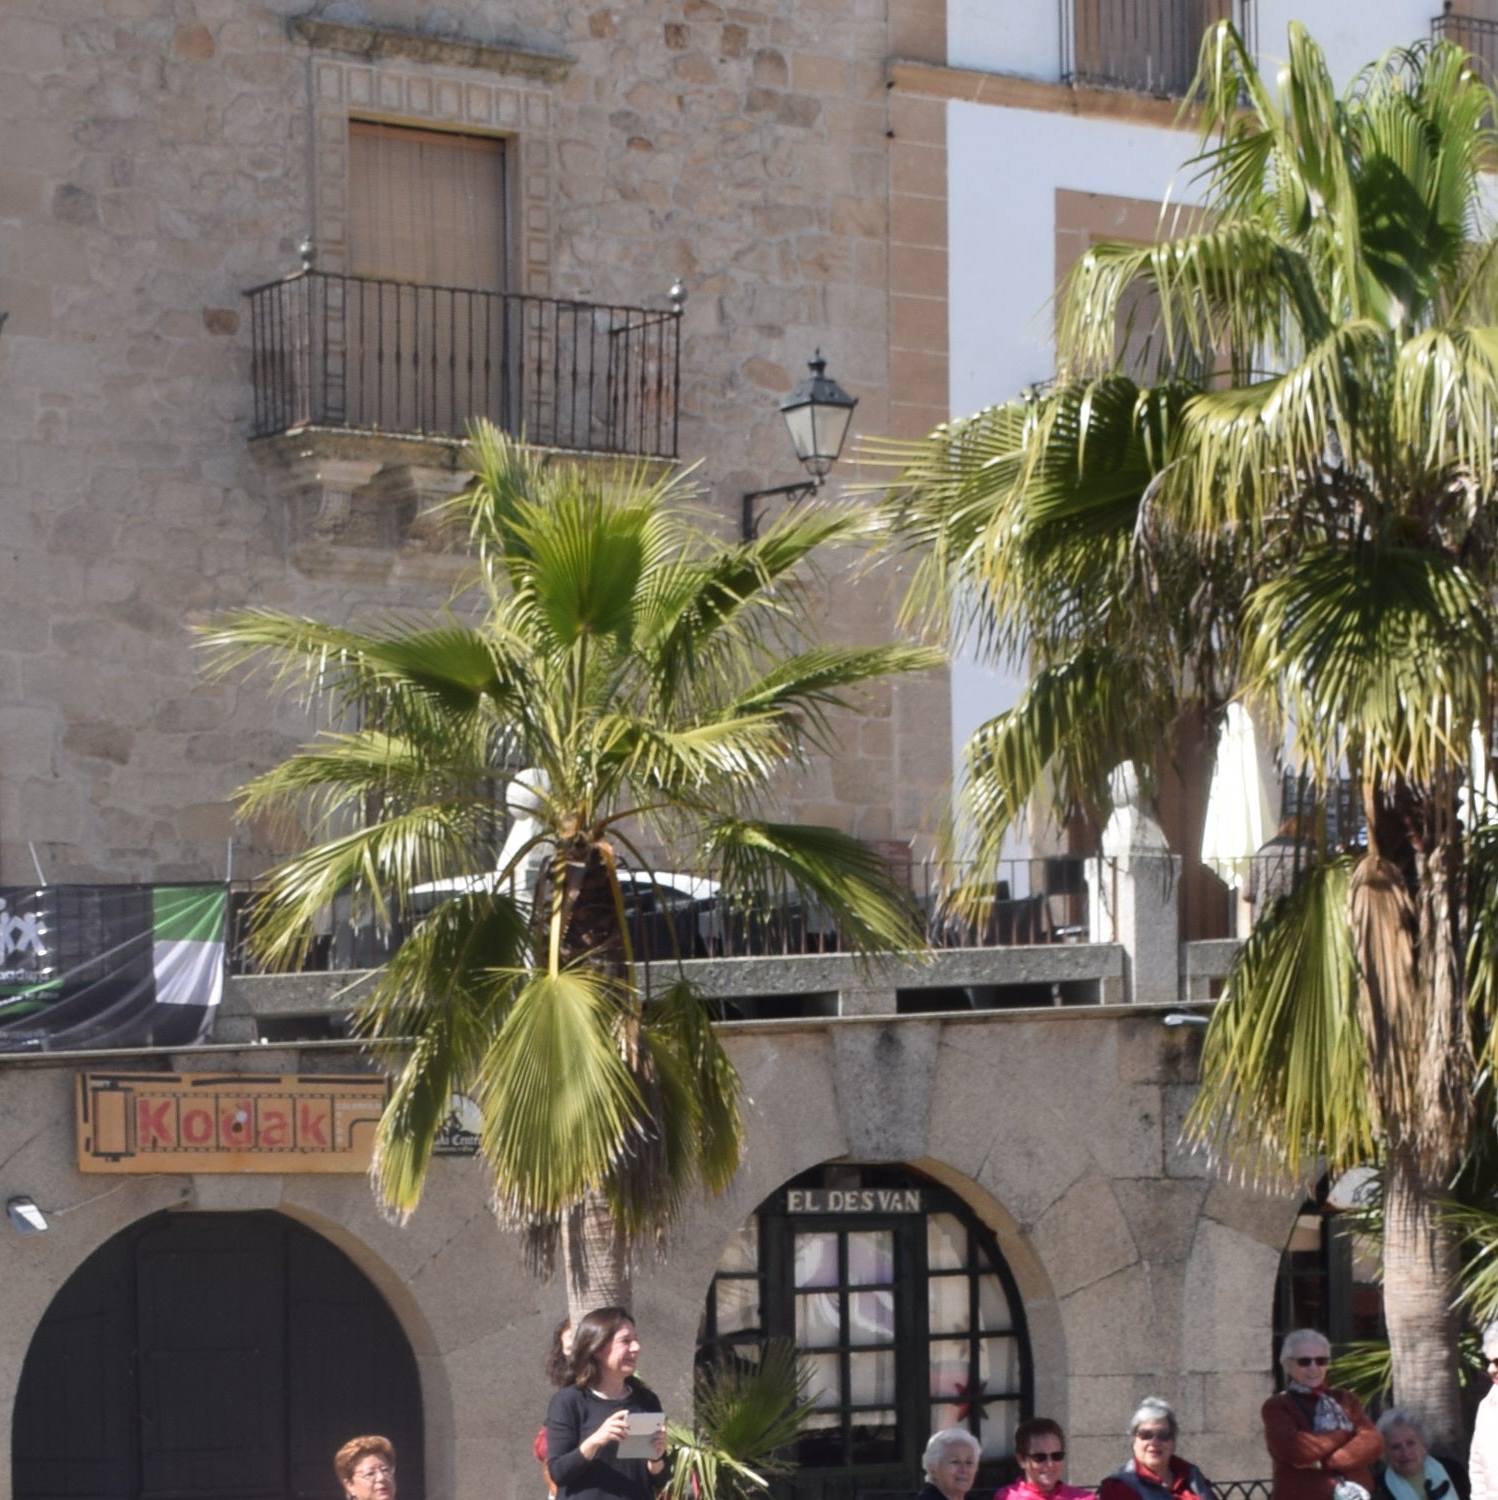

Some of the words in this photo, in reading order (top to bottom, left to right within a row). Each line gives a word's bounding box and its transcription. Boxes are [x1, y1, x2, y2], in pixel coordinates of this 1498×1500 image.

[137, 1097, 329, 1148] Kodak
[787, 1190, 821, 1213] EL
[827, 1189, 921, 1213] DESVAN
